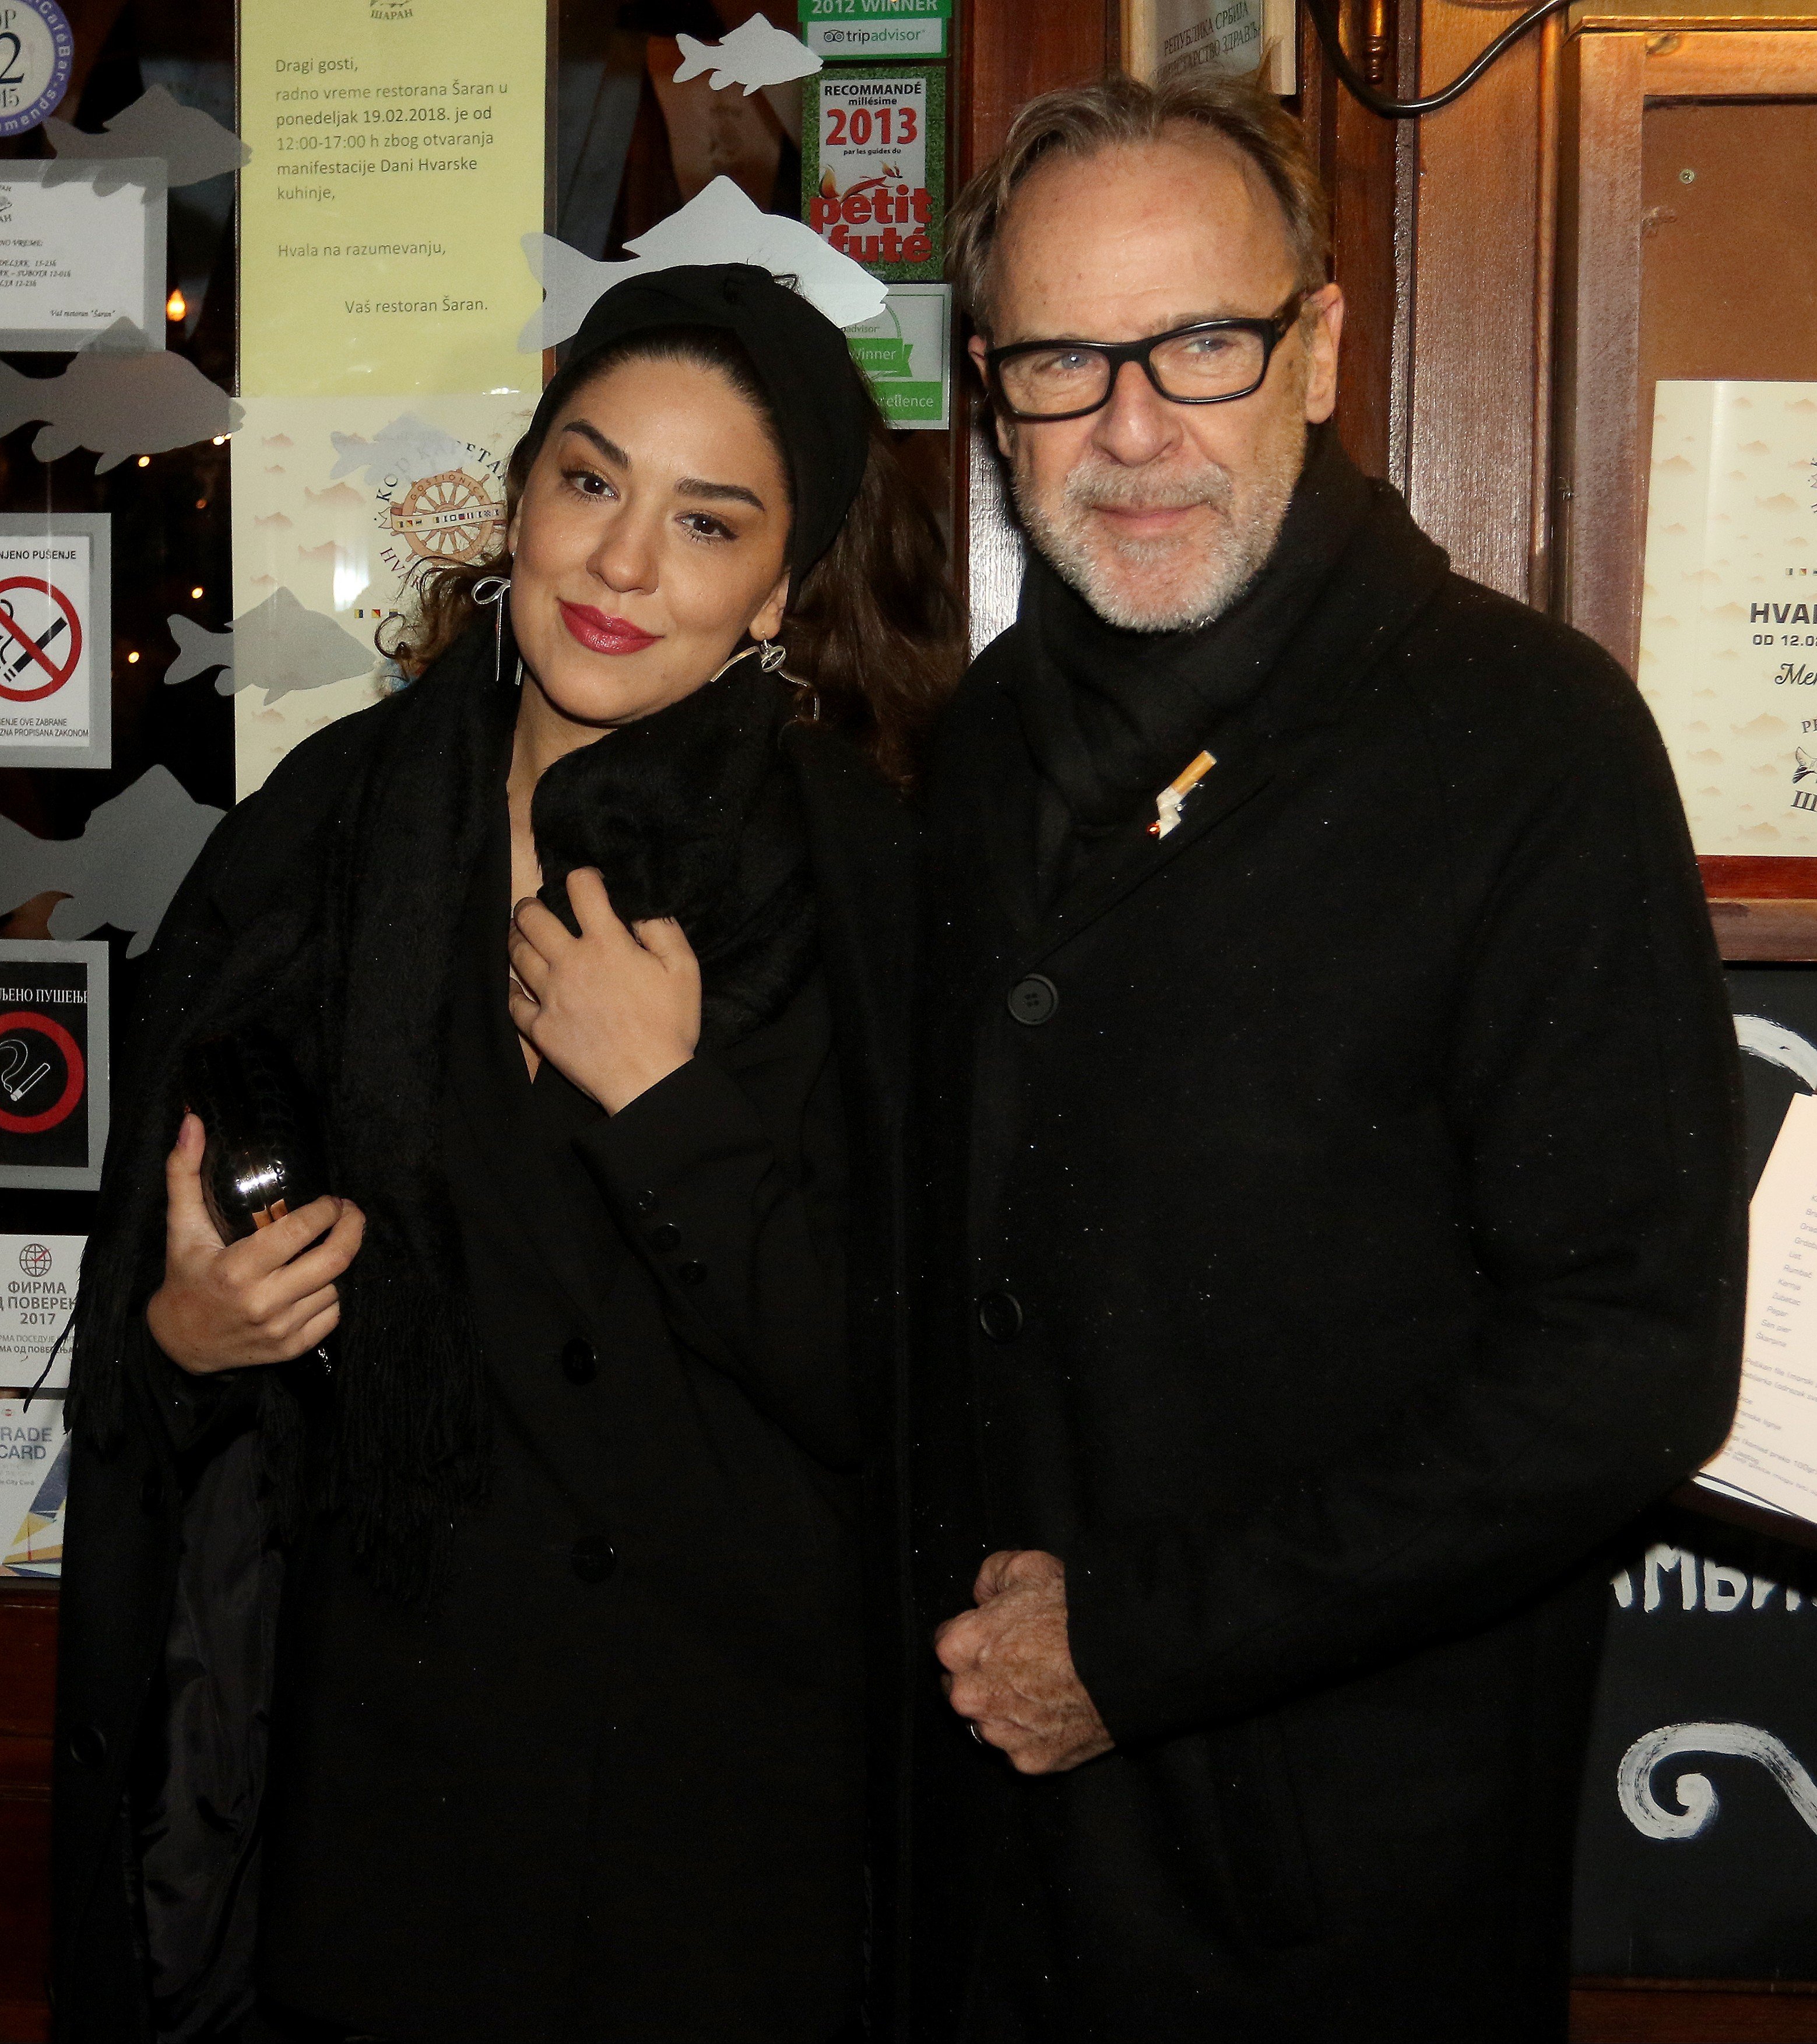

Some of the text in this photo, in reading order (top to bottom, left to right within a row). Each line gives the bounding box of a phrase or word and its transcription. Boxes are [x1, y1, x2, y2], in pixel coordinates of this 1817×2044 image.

[370, 9, 413, 20] ШАРАН
[812, 0, 938, 14] 2012 WINNER
[846, 29, 921, 44] tripadvisor
[276, 57, 359, 74] Dragi gosti,
[276, 79, 508, 102] radno vreme restorana Šaran u
[824, 82, 922, 96] RECOMMANDÉ
[848, 97, 897, 106] millésime
[276, 107, 492, 126] ponedeljak 19.02.2018. je od
[826, 107, 918, 146] 2013
[277, 132, 493, 150] 12:00-17:00 h zbog otvaranja
[867, 148, 890, 156] guides
[277, 157, 477, 176] manifestacije Dani Hvarske
[277, 186, 335, 201] kuhinje,
[810, 184, 933, 234] petit
[278, 241, 446, 257] Hvala na razumevanju,
[828, 224, 933, 262] futé
[345, 295, 488, 314] Vaš restoran Šaran.
[410, 473, 485, 501] GOSTIONICA
[33, 548, 76, 560] PUŠENJE
[1751, 603, 1817, 624] HVA
[1753, 634, 1817, 647] OD 12.0
[19, 717, 34, 726] OVE
[36, 717, 67, 726] ZABRANE
[15, 728, 54, 736] PROPISANA
[55, 729, 89, 737] ZAKONOM
[8, 1281, 66, 1294] ФИРМА
[20, 1313, 55, 1325] 2017
[13, 1346, 26, 1354] ОД
